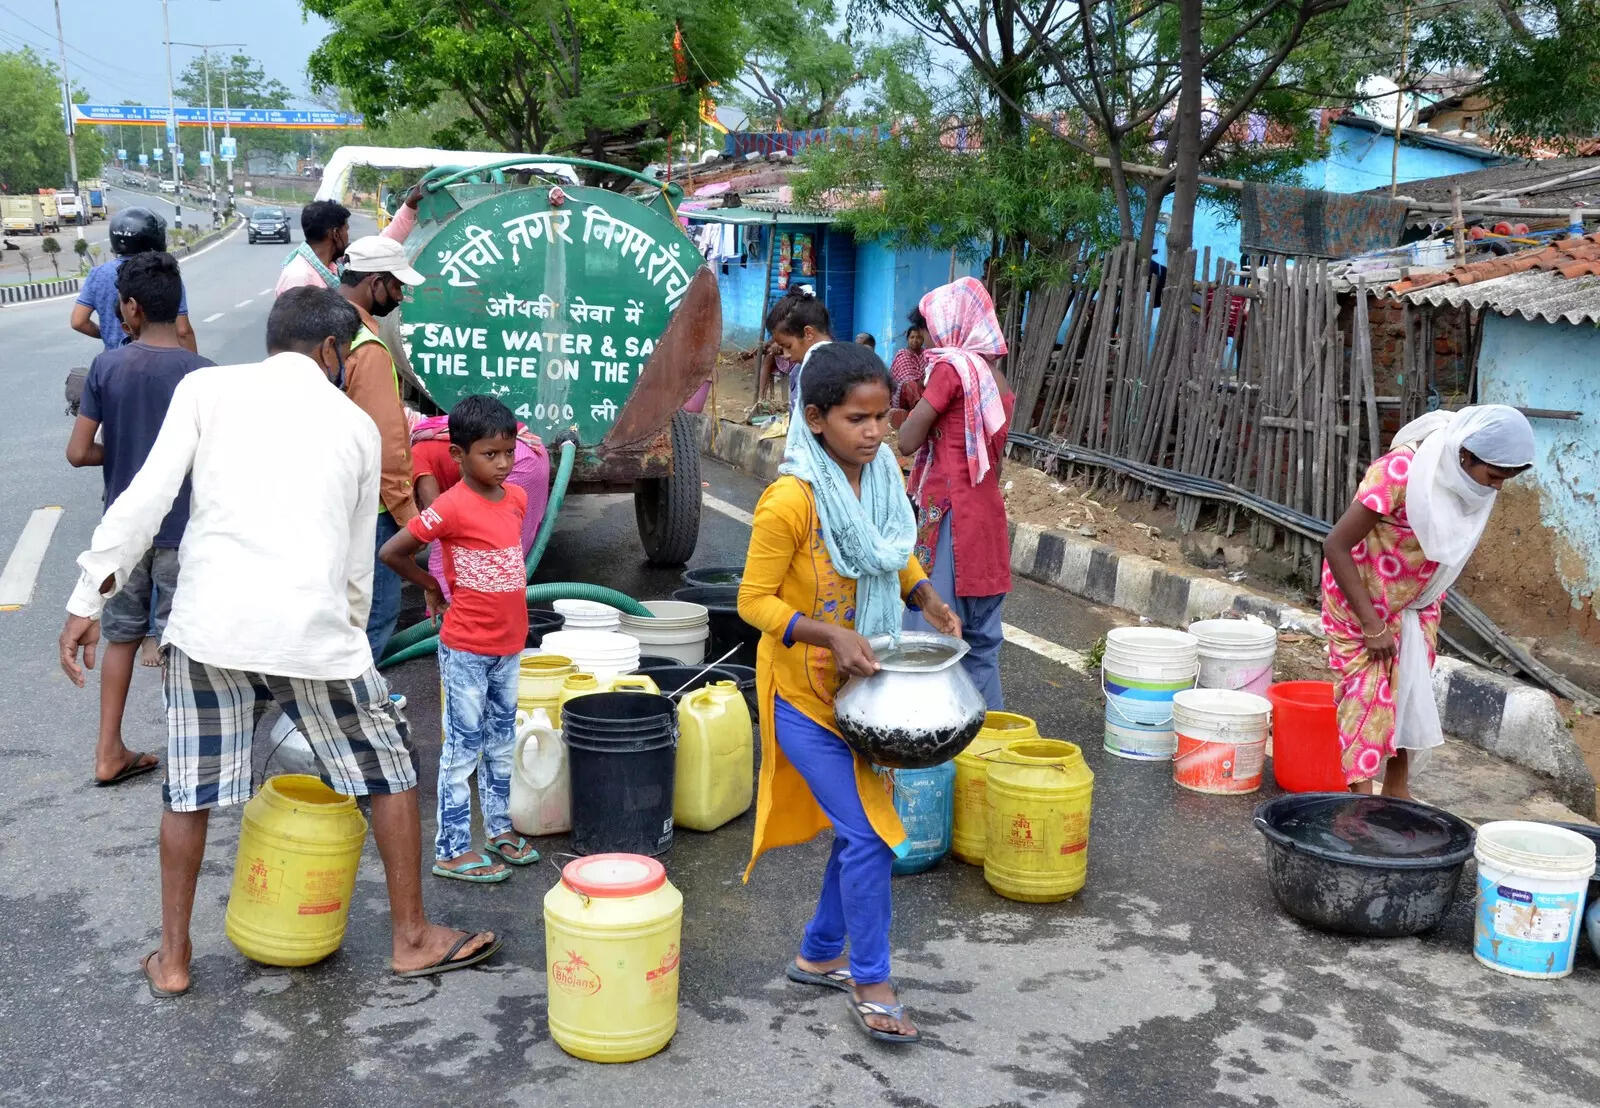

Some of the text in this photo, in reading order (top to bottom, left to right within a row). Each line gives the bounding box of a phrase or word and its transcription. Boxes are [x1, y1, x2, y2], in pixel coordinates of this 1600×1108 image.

[502, 210, 573, 250] नगर
[647, 243, 690, 312] राँच
[570, 296, 615, 324] सेवा
[624, 299, 644, 325] में
[423, 323, 659, 358] SAVE WATER & SA
[417, 353, 469, 376] THE
[481, 355, 537, 379] LIFE
[547, 359, 579, 380] ON
[591, 361, 630, 384] THE
[515, 403, 574, 420] 4000
